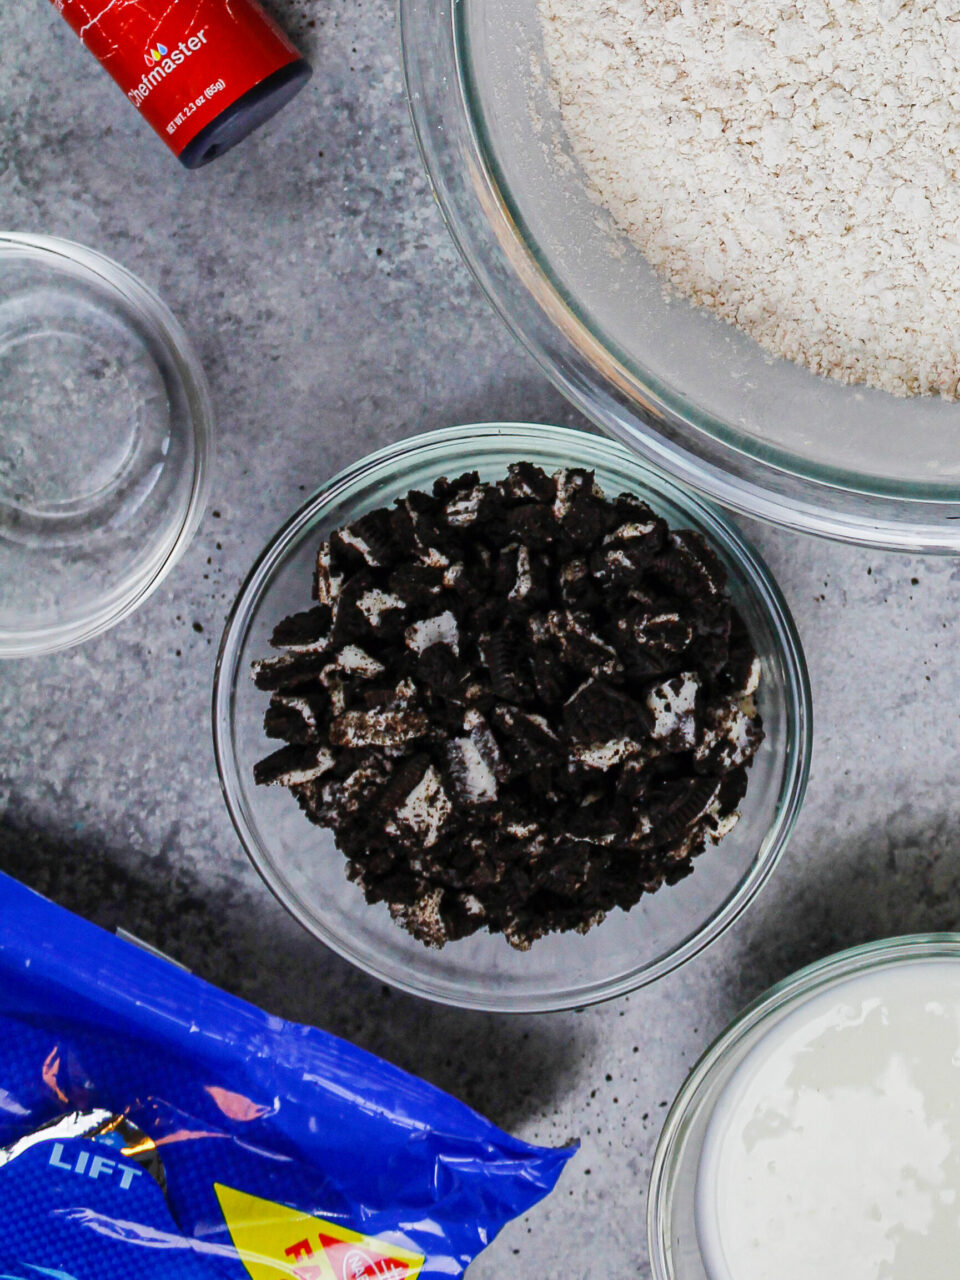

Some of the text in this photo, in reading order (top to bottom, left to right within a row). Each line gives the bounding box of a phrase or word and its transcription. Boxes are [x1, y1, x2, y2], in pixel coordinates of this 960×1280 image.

[183, 102, 197, 117] 2.3
[195, 95, 206, 107] oz
[204, 78, 227, 99] (65g)
[49, 1142, 143, 1191] LIFT
